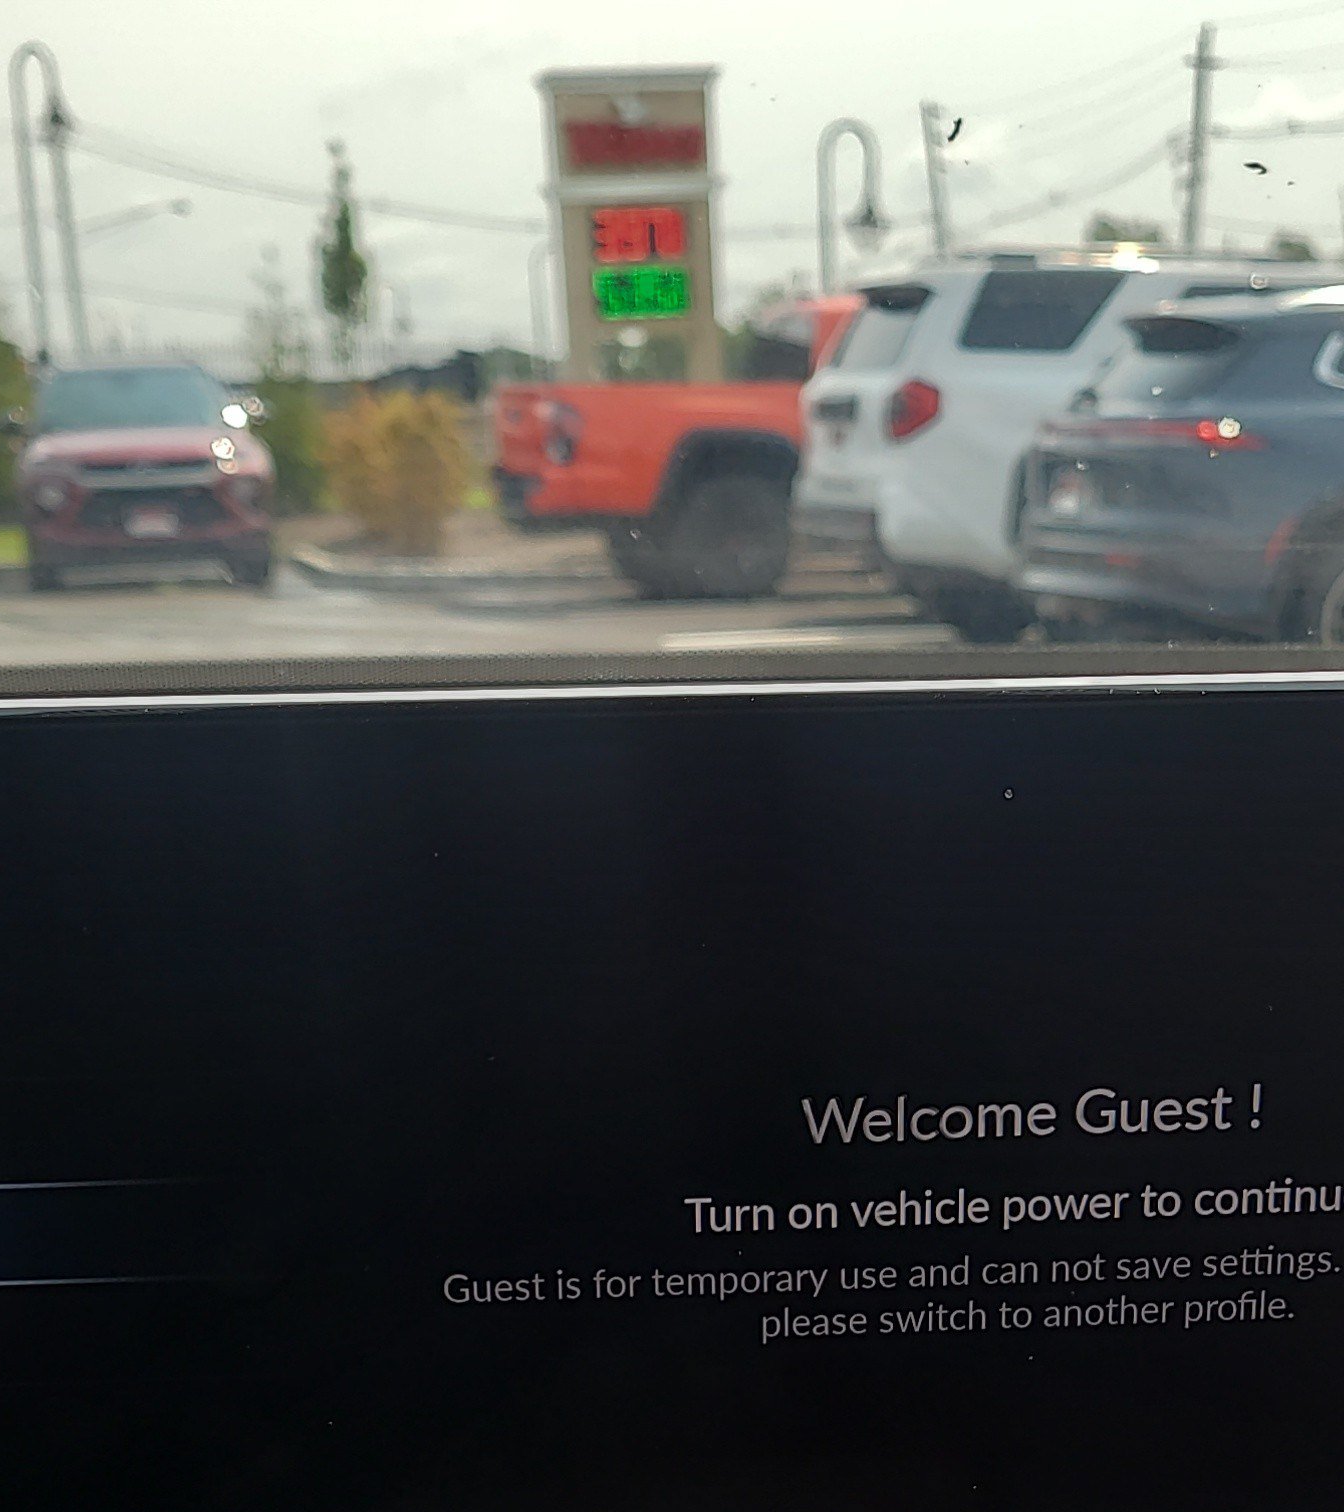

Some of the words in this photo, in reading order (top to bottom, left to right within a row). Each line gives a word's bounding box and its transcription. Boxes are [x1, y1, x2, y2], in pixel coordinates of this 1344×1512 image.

[802, 1096, 1056, 1143] Welcome
[1076, 1088, 1232, 1133] Guest
[684, 1198, 774, 1233] Turn
[789, 1203, 837, 1229] on
[851, 1188, 989, 1227] vehicle
[1004, 1193, 1129, 1230] power
[1141, 1185, 1181, 1217] to
[444, 1274, 545, 1303] Guest
[557, 1270, 580, 1299] is
[593, 1269, 641, 1298] for
[652, 1269, 828, 1300] temporary
[841, 1267, 897, 1289] use
[909, 1255, 969, 1287] and
[982, 1262, 1038, 1284] can
[1052, 1254, 1106, 1282] not
[1117, 1257, 1190, 1279] save
[1203, 1245, 1340, 1280] settings.
[763, 1307, 867, 1344] please
[880, 1300, 986, 1333] switch
[999, 1302, 1032, 1328] to
[1044, 1295, 1174, 1327] another
[1185, 1290, 1294, 1328] profile.
